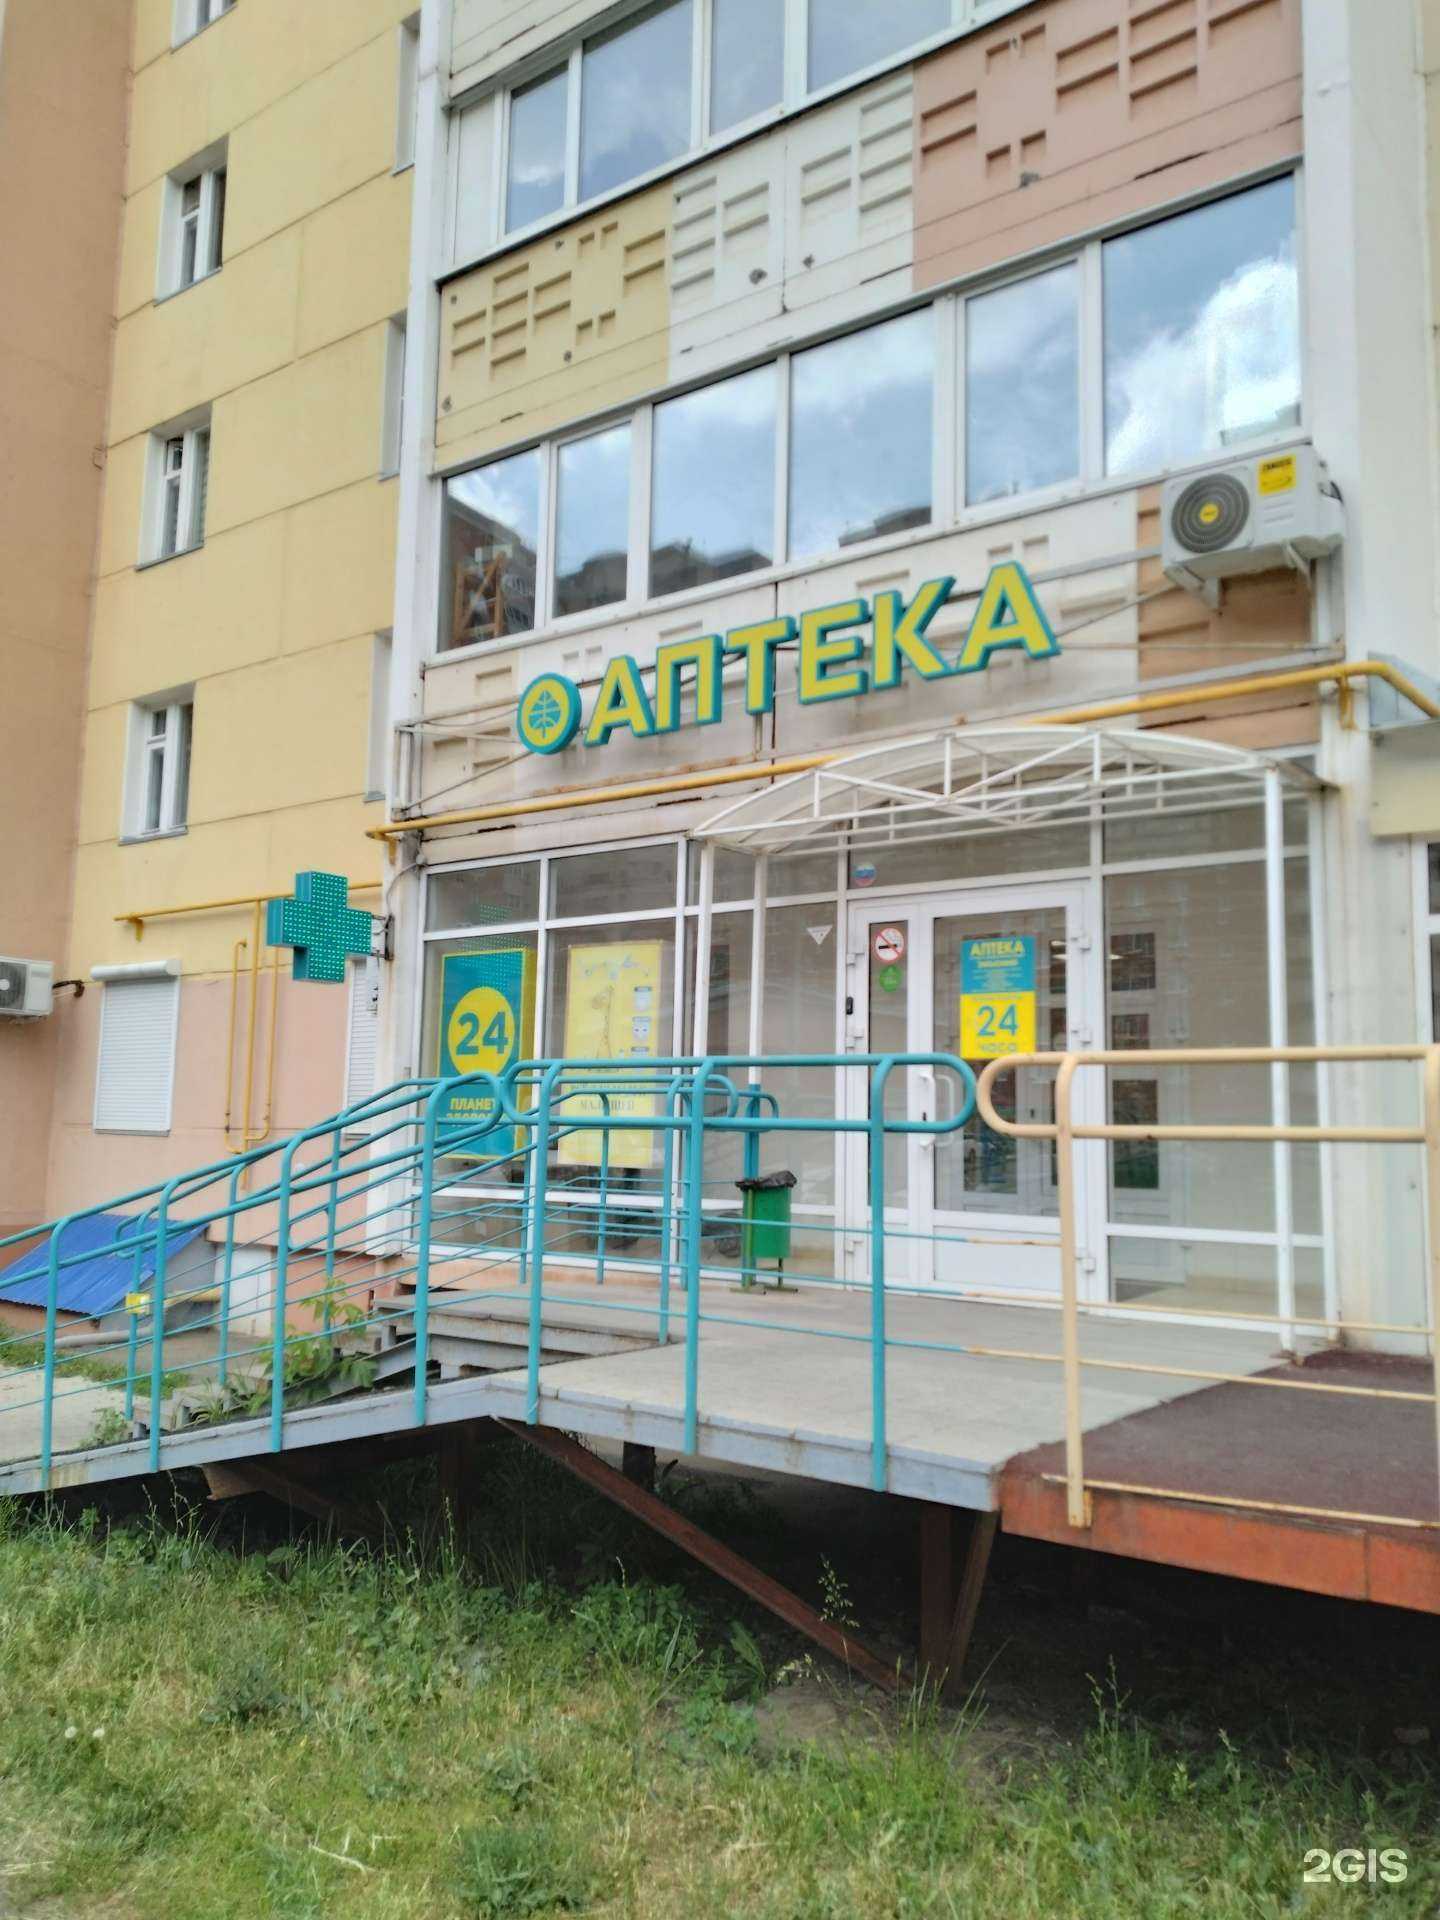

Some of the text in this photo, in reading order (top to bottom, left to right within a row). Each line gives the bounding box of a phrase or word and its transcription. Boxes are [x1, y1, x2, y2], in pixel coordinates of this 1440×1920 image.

[583, 561, 1061, 747] АПТЕКА
[969, 940, 1026, 958] АПТЕКА
[455, 1010, 509, 1056] 24
[976, 1003, 1019, 1037] 24
